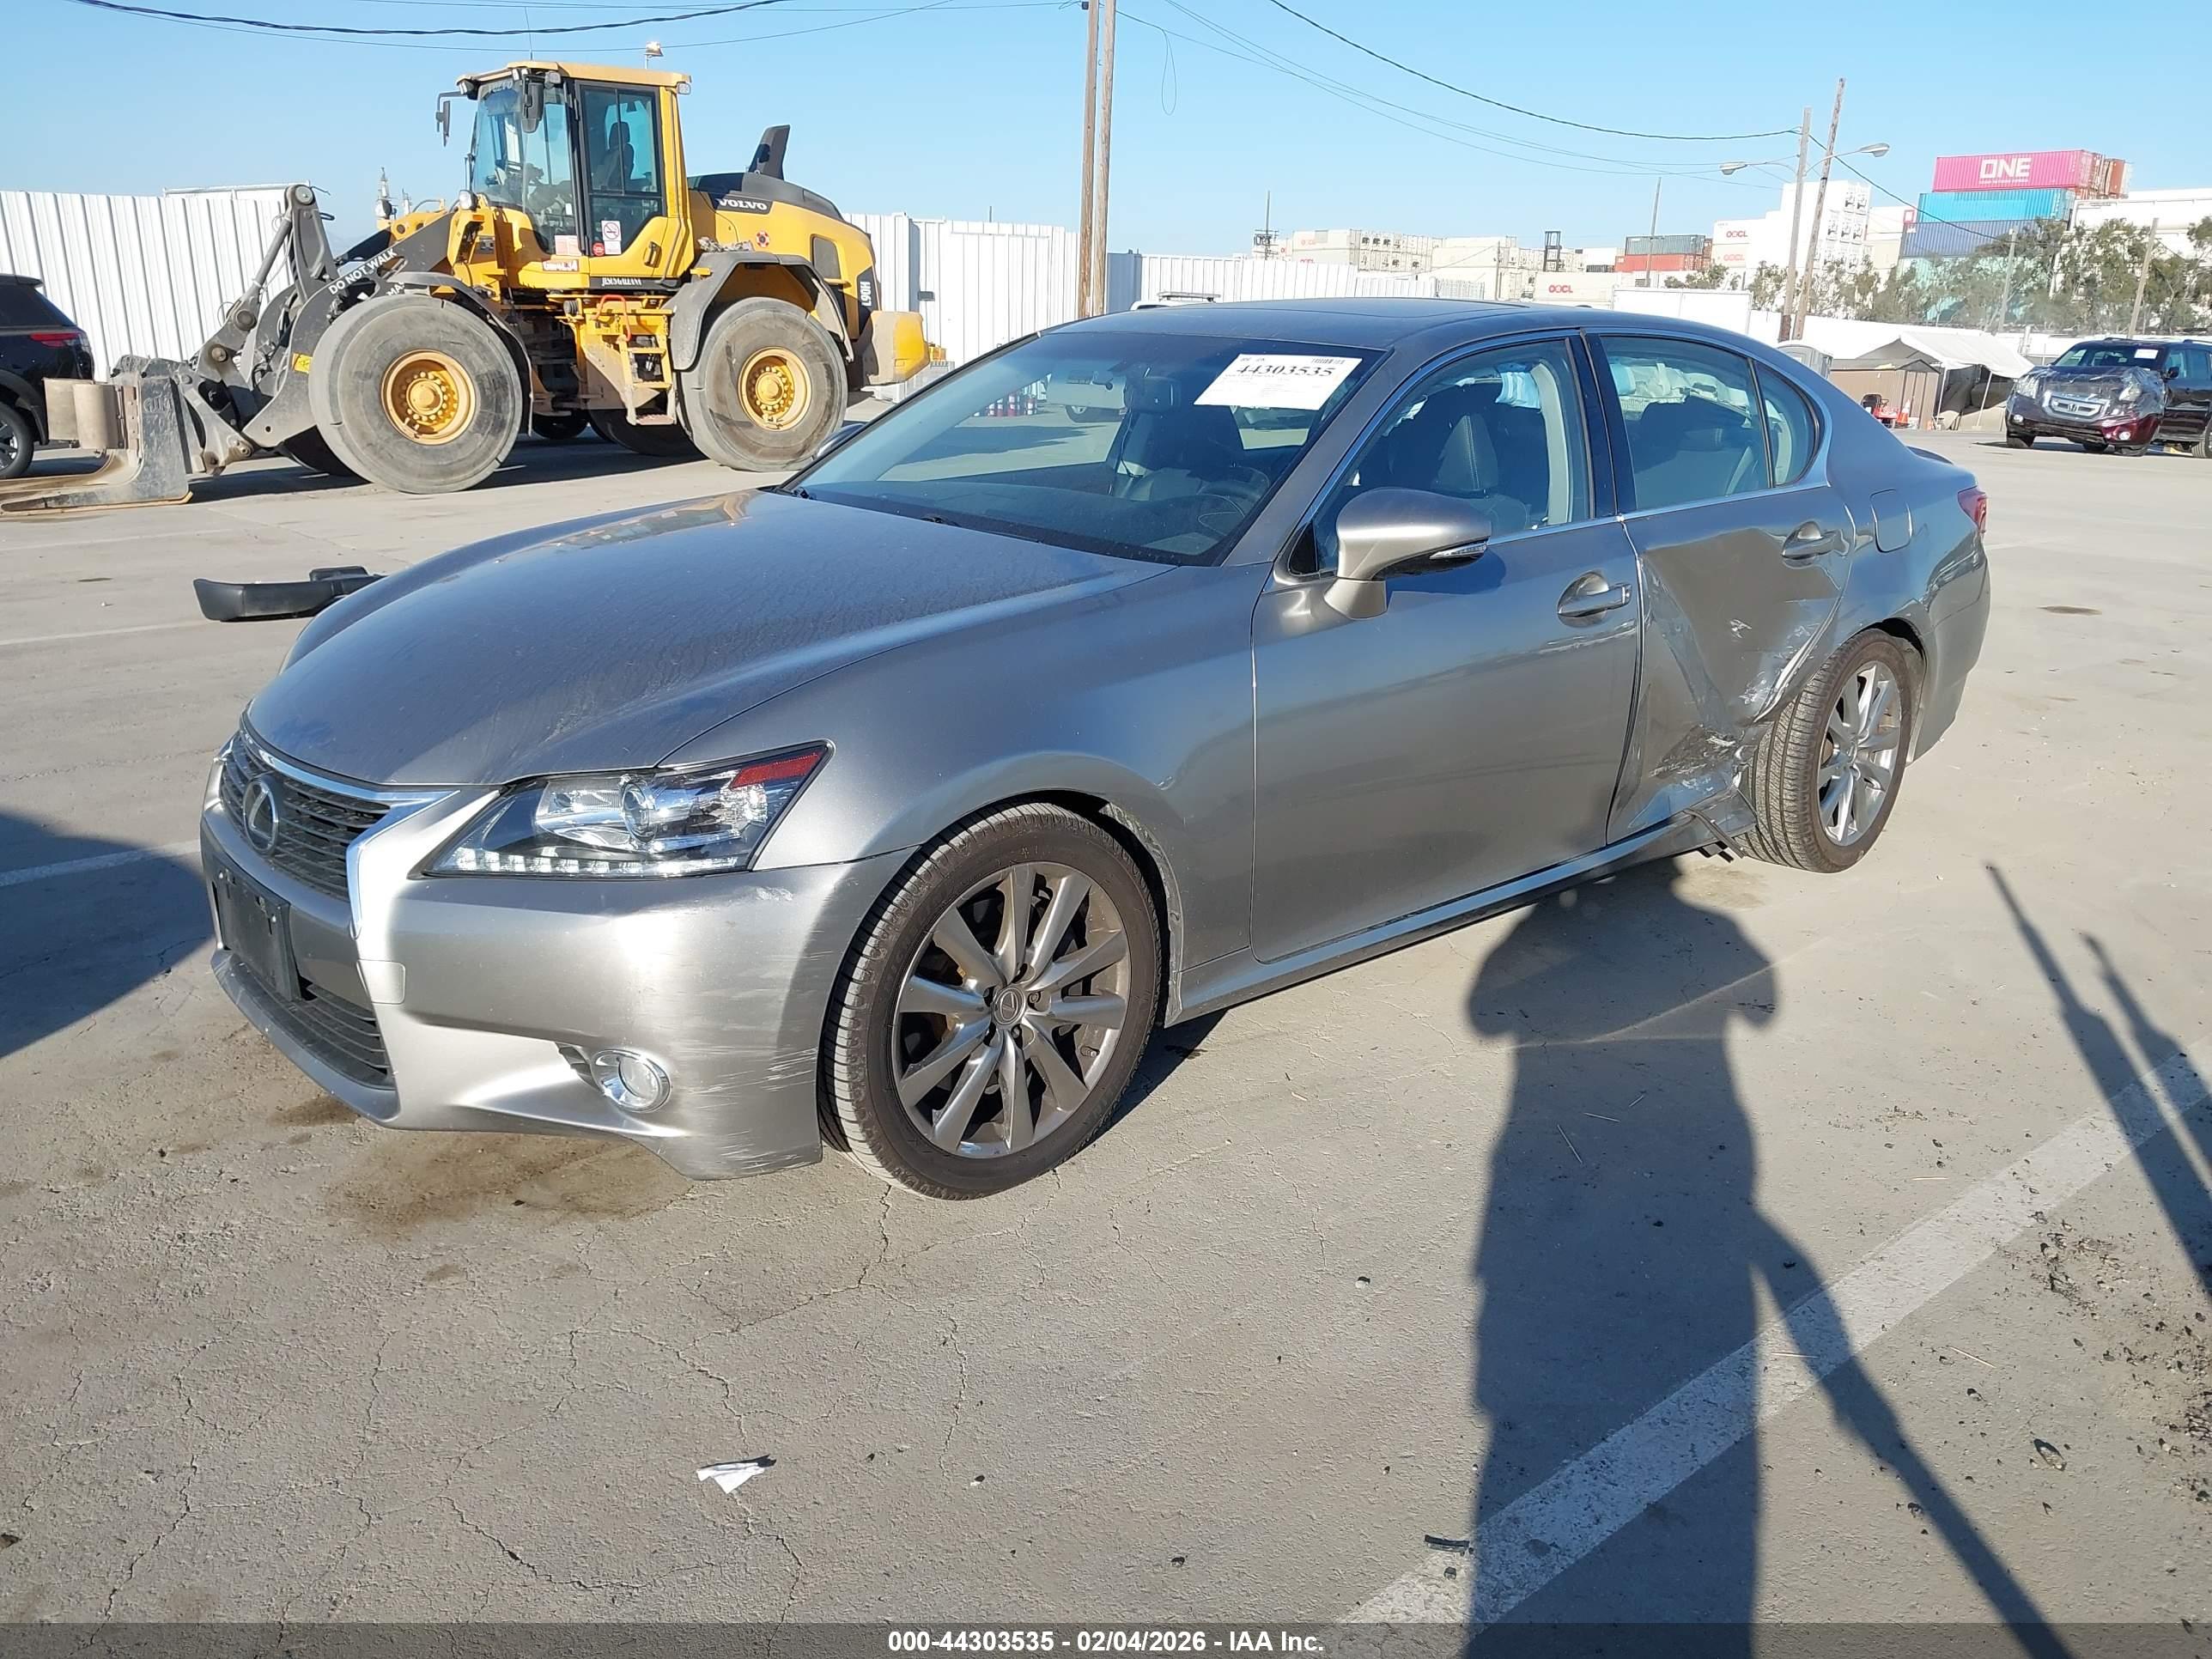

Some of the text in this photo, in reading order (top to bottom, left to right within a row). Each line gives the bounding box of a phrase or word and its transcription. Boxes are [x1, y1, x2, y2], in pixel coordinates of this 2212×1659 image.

[1979, 157, 2033, 179] ONE
[715, 198, 768, 210] VOLVO
[328, 248, 398, 295] DO NOT WALK
[860, 281, 872, 307] L90H
[1548, 284, 1573, 293] OOCL
[1237, 365, 1335, 377] 44303535
